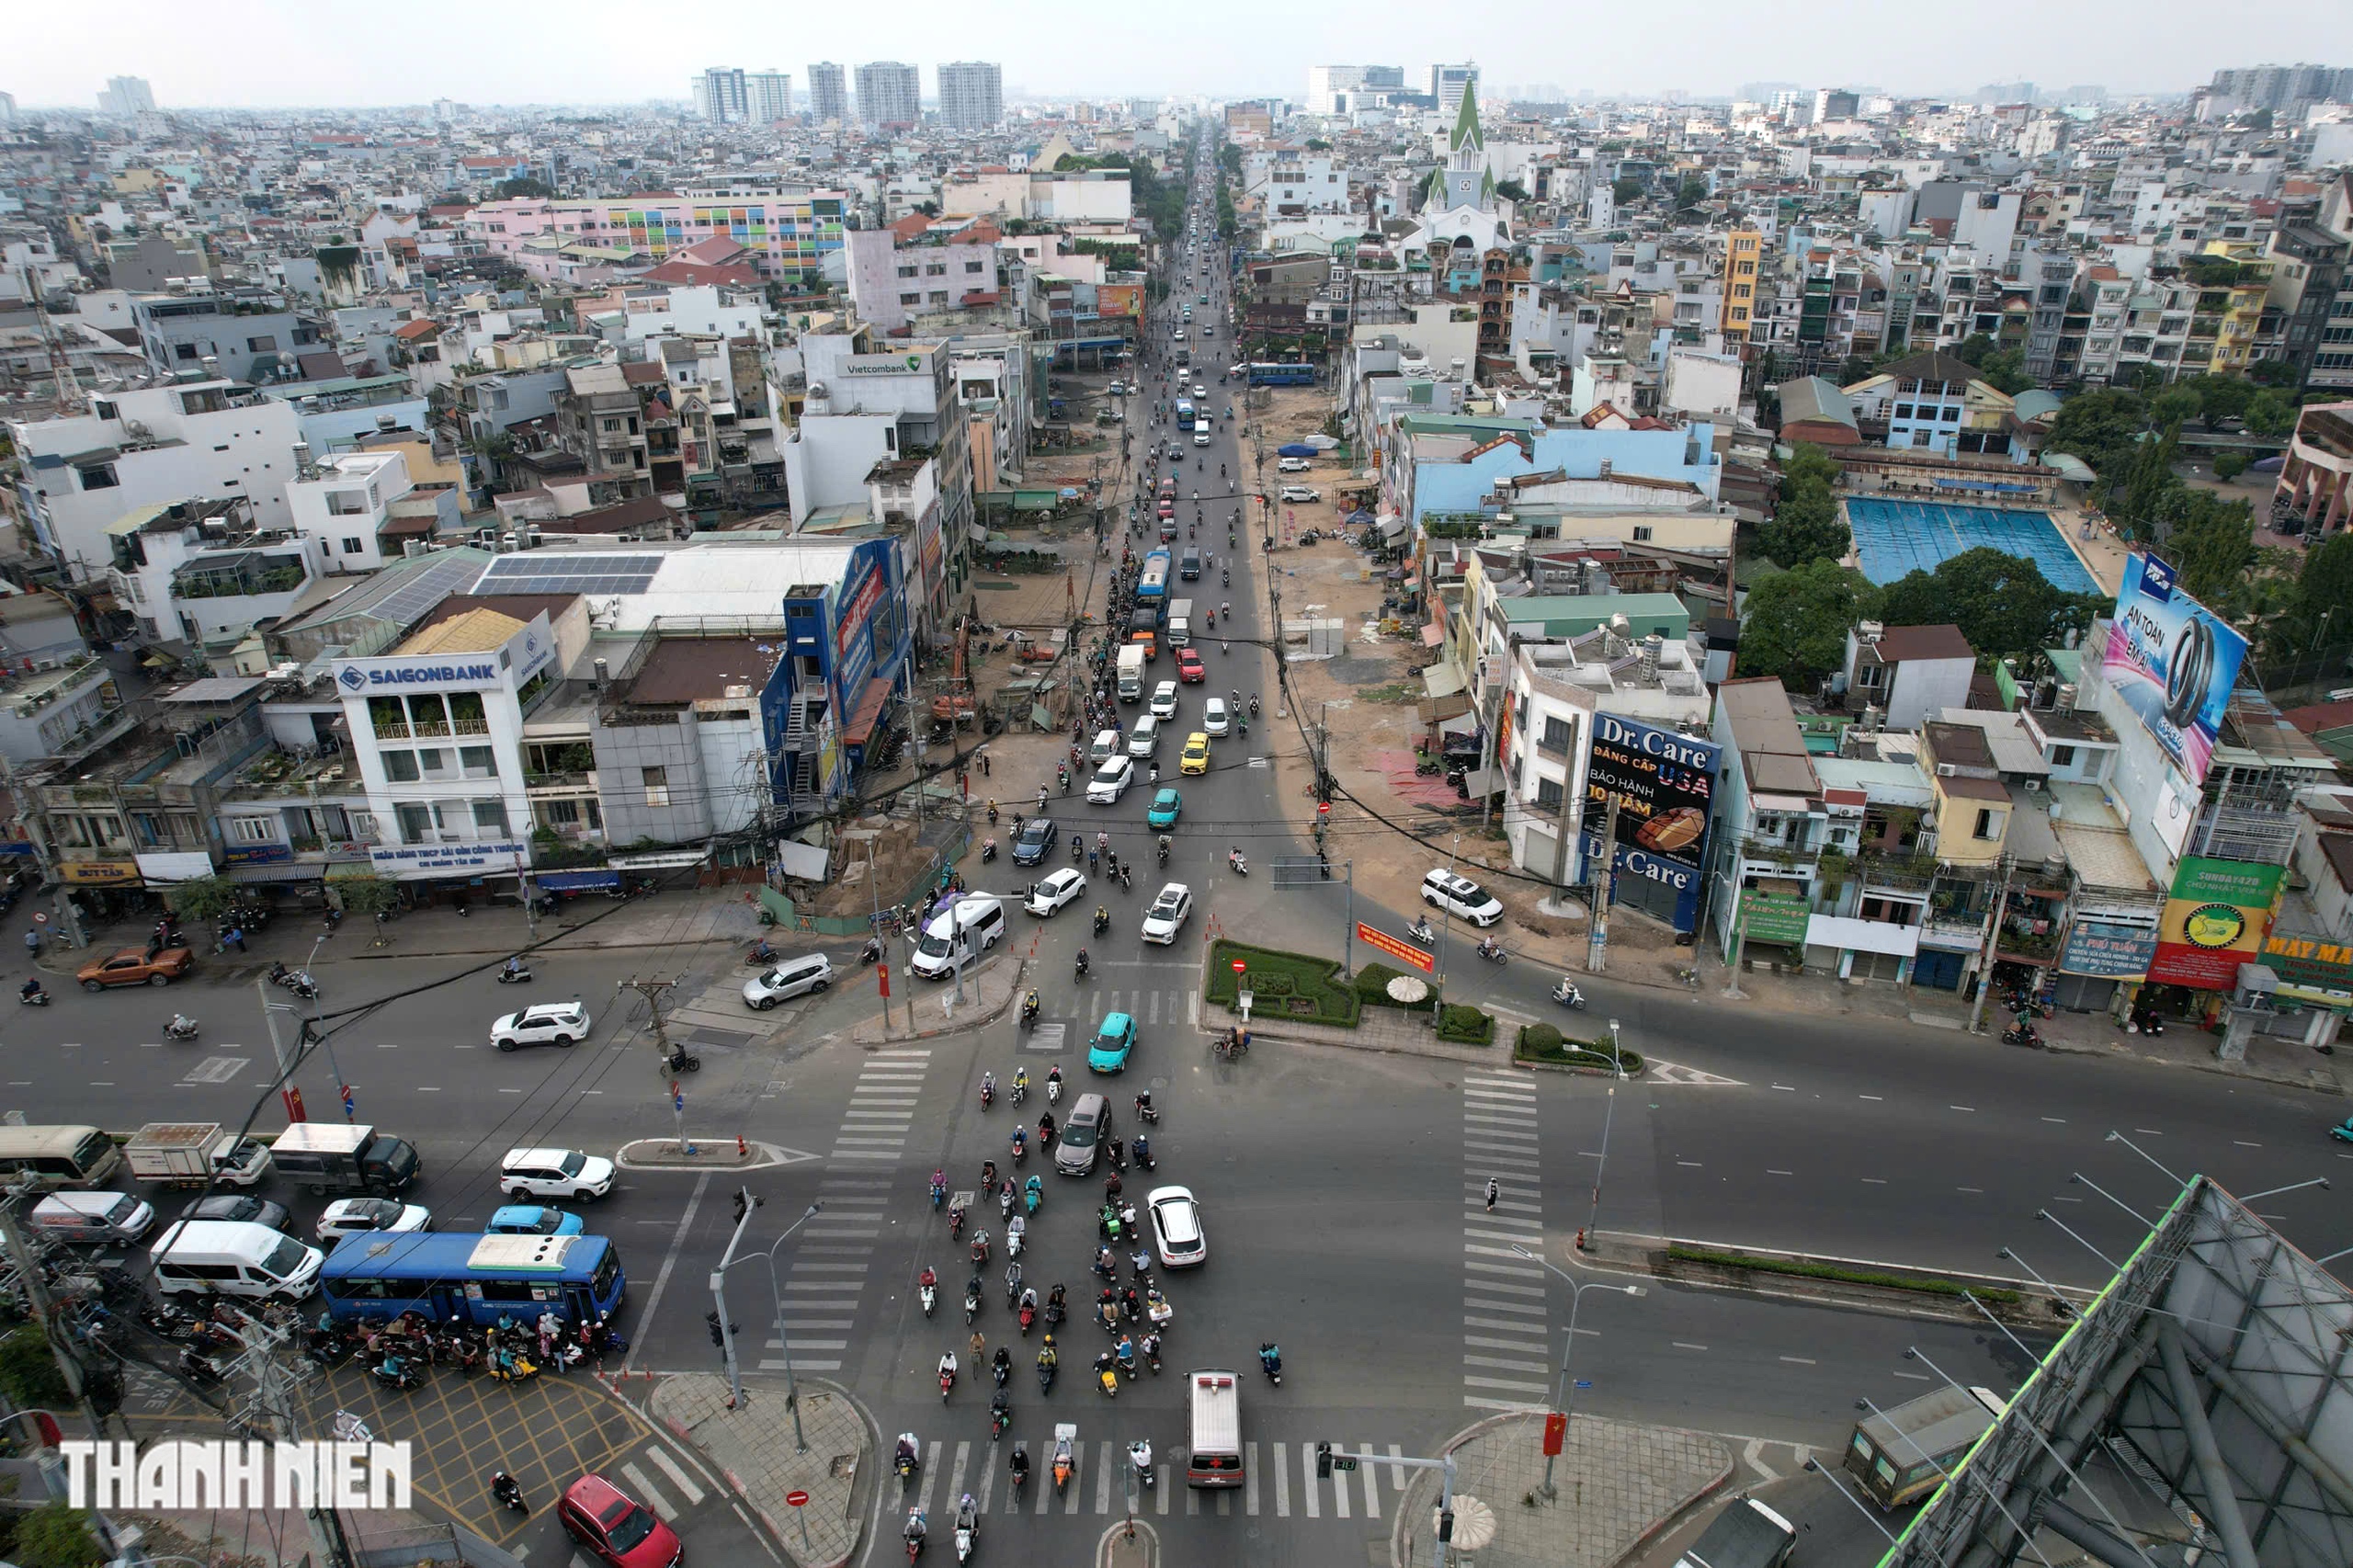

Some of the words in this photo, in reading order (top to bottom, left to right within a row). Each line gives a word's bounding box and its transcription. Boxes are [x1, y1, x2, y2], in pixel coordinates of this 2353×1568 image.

[847, 363, 908, 375] Vietcombank
[2127, 606, 2143, 629] AN
[2142, 613, 2165, 648] TOÀN
[521, 650, 548, 677] SAIGONBANK
[2126, 637, 2139, 664] ÊM
[2139, 653, 2149, 672] ÁI
[369, 665, 495, 684] SAIGONBANK
[1589, 783, 1606, 801] 10
[1590, 769, 1616, 786] BẢO
[1619, 773, 1654, 798] HÀNH
[1658, 764, 1710, 799] USA
[417, 849, 439, 858] TMCP
[441, 846, 454, 856] SÀI
[2086, 938, 2109, 949] PHÚ
